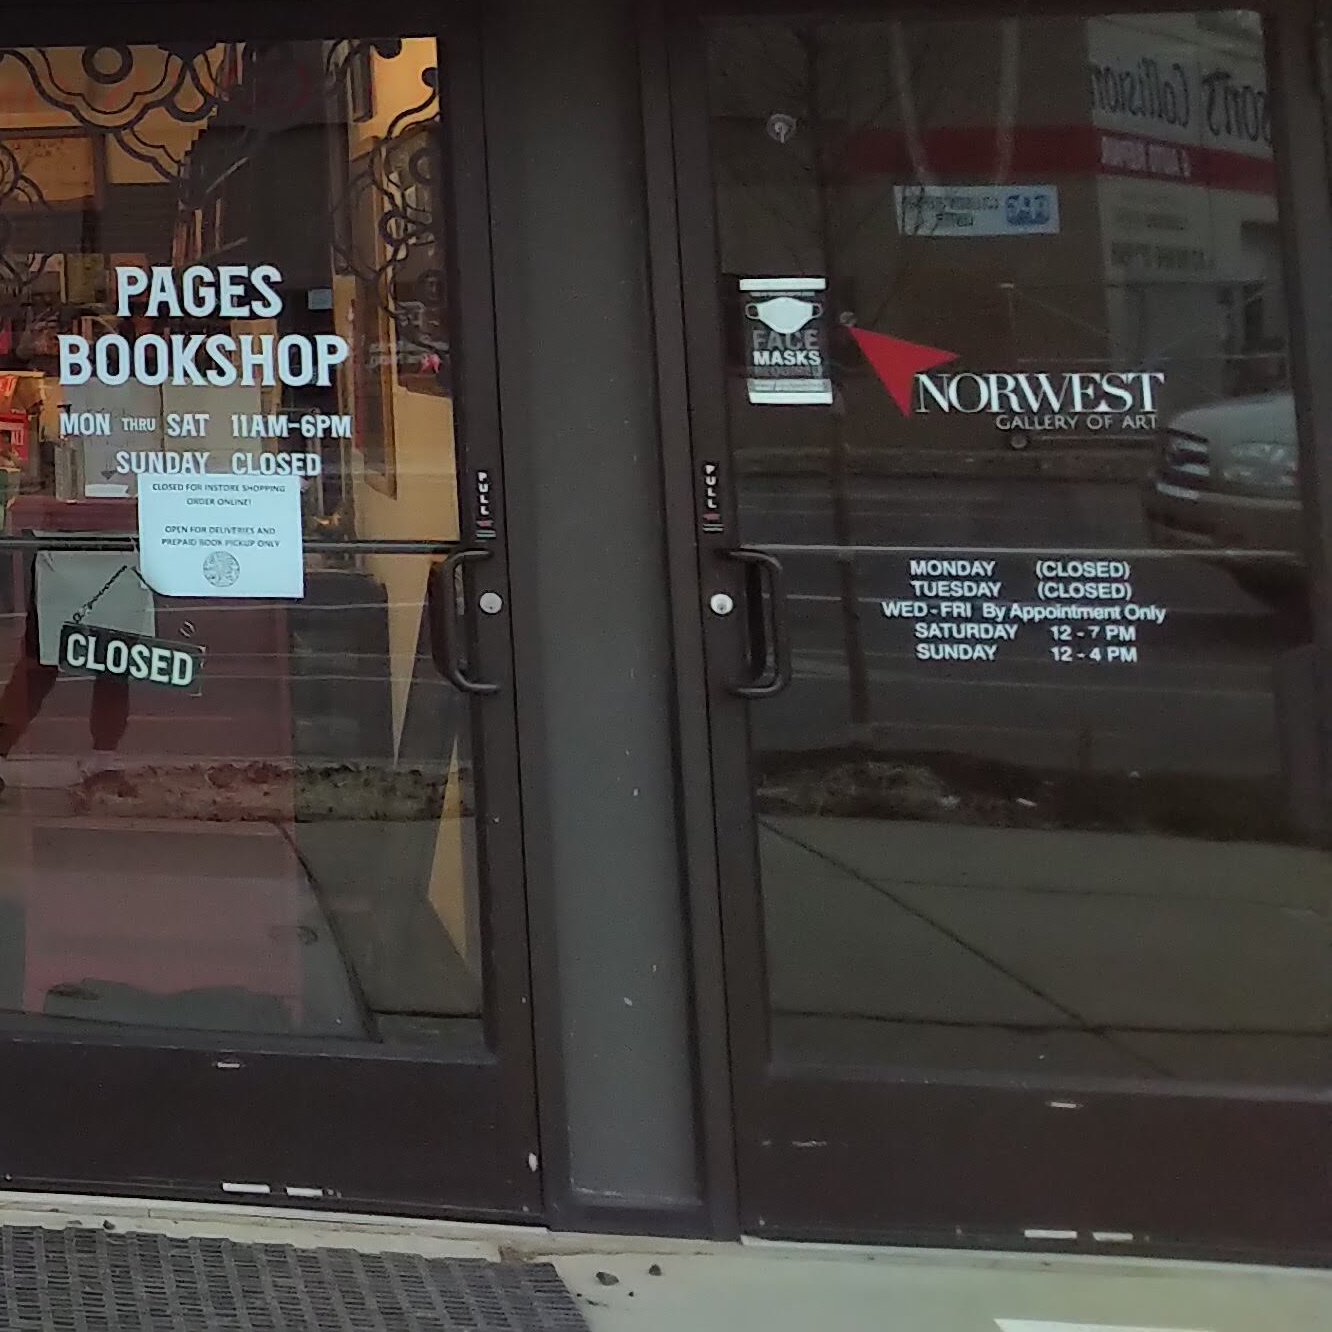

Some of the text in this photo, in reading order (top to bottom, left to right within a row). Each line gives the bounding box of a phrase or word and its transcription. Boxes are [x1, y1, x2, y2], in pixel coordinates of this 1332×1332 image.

[114, 265, 283, 318] PAGES
[752, 328, 820, 350] FACE
[56, 334, 350, 388] BOOKSHOP
[752, 350, 822, 366] MASKS
[913, 372, 1165, 414] NORWEST
[59, 413, 353, 439] MON THRU SAT 11AM-6PM
[995, 414, 1158, 430] GALLERY OF ART
[115, 451, 323, 477] SUNDAY CLOSED
[151, 483, 286, 493] CLOSED FOR INSTORE SHOPPING
[477, 471, 490, 516] PULL
[704, 464, 718, 509] PULL
[186, 497, 252, 506] ORDER ONLINE!
[164, 525, 276, 535] OPEN FOR DELIVERIES AND
[161, 538, 281, 548] PREPAID BOOK PICKUP ONLY
[909, 560, 1131, 580] MONDAY (CLOSED)
[911, 581, 1132, 601] TUESDAY (CLOSED)
[982, 602, 1006, 622] By
[1009, 603, 1122, 623] Appointment
[1124, 604, 1167, 624] Only
[914, 623, 1019, 640] SATURDAY
[1049, 625, 1073, 641] 12
[1088, 625, 1101, 641] 7
[1105, 625, 1137, 642] PM
[65, 632, 194, 687] CLOSED
[916, 643, 998, 661] SUNDAY
[1050, 646, 1073, 662] 12
[1088, 646, 1102, 662] 4
[1106, 646, 1138, 663] PM
